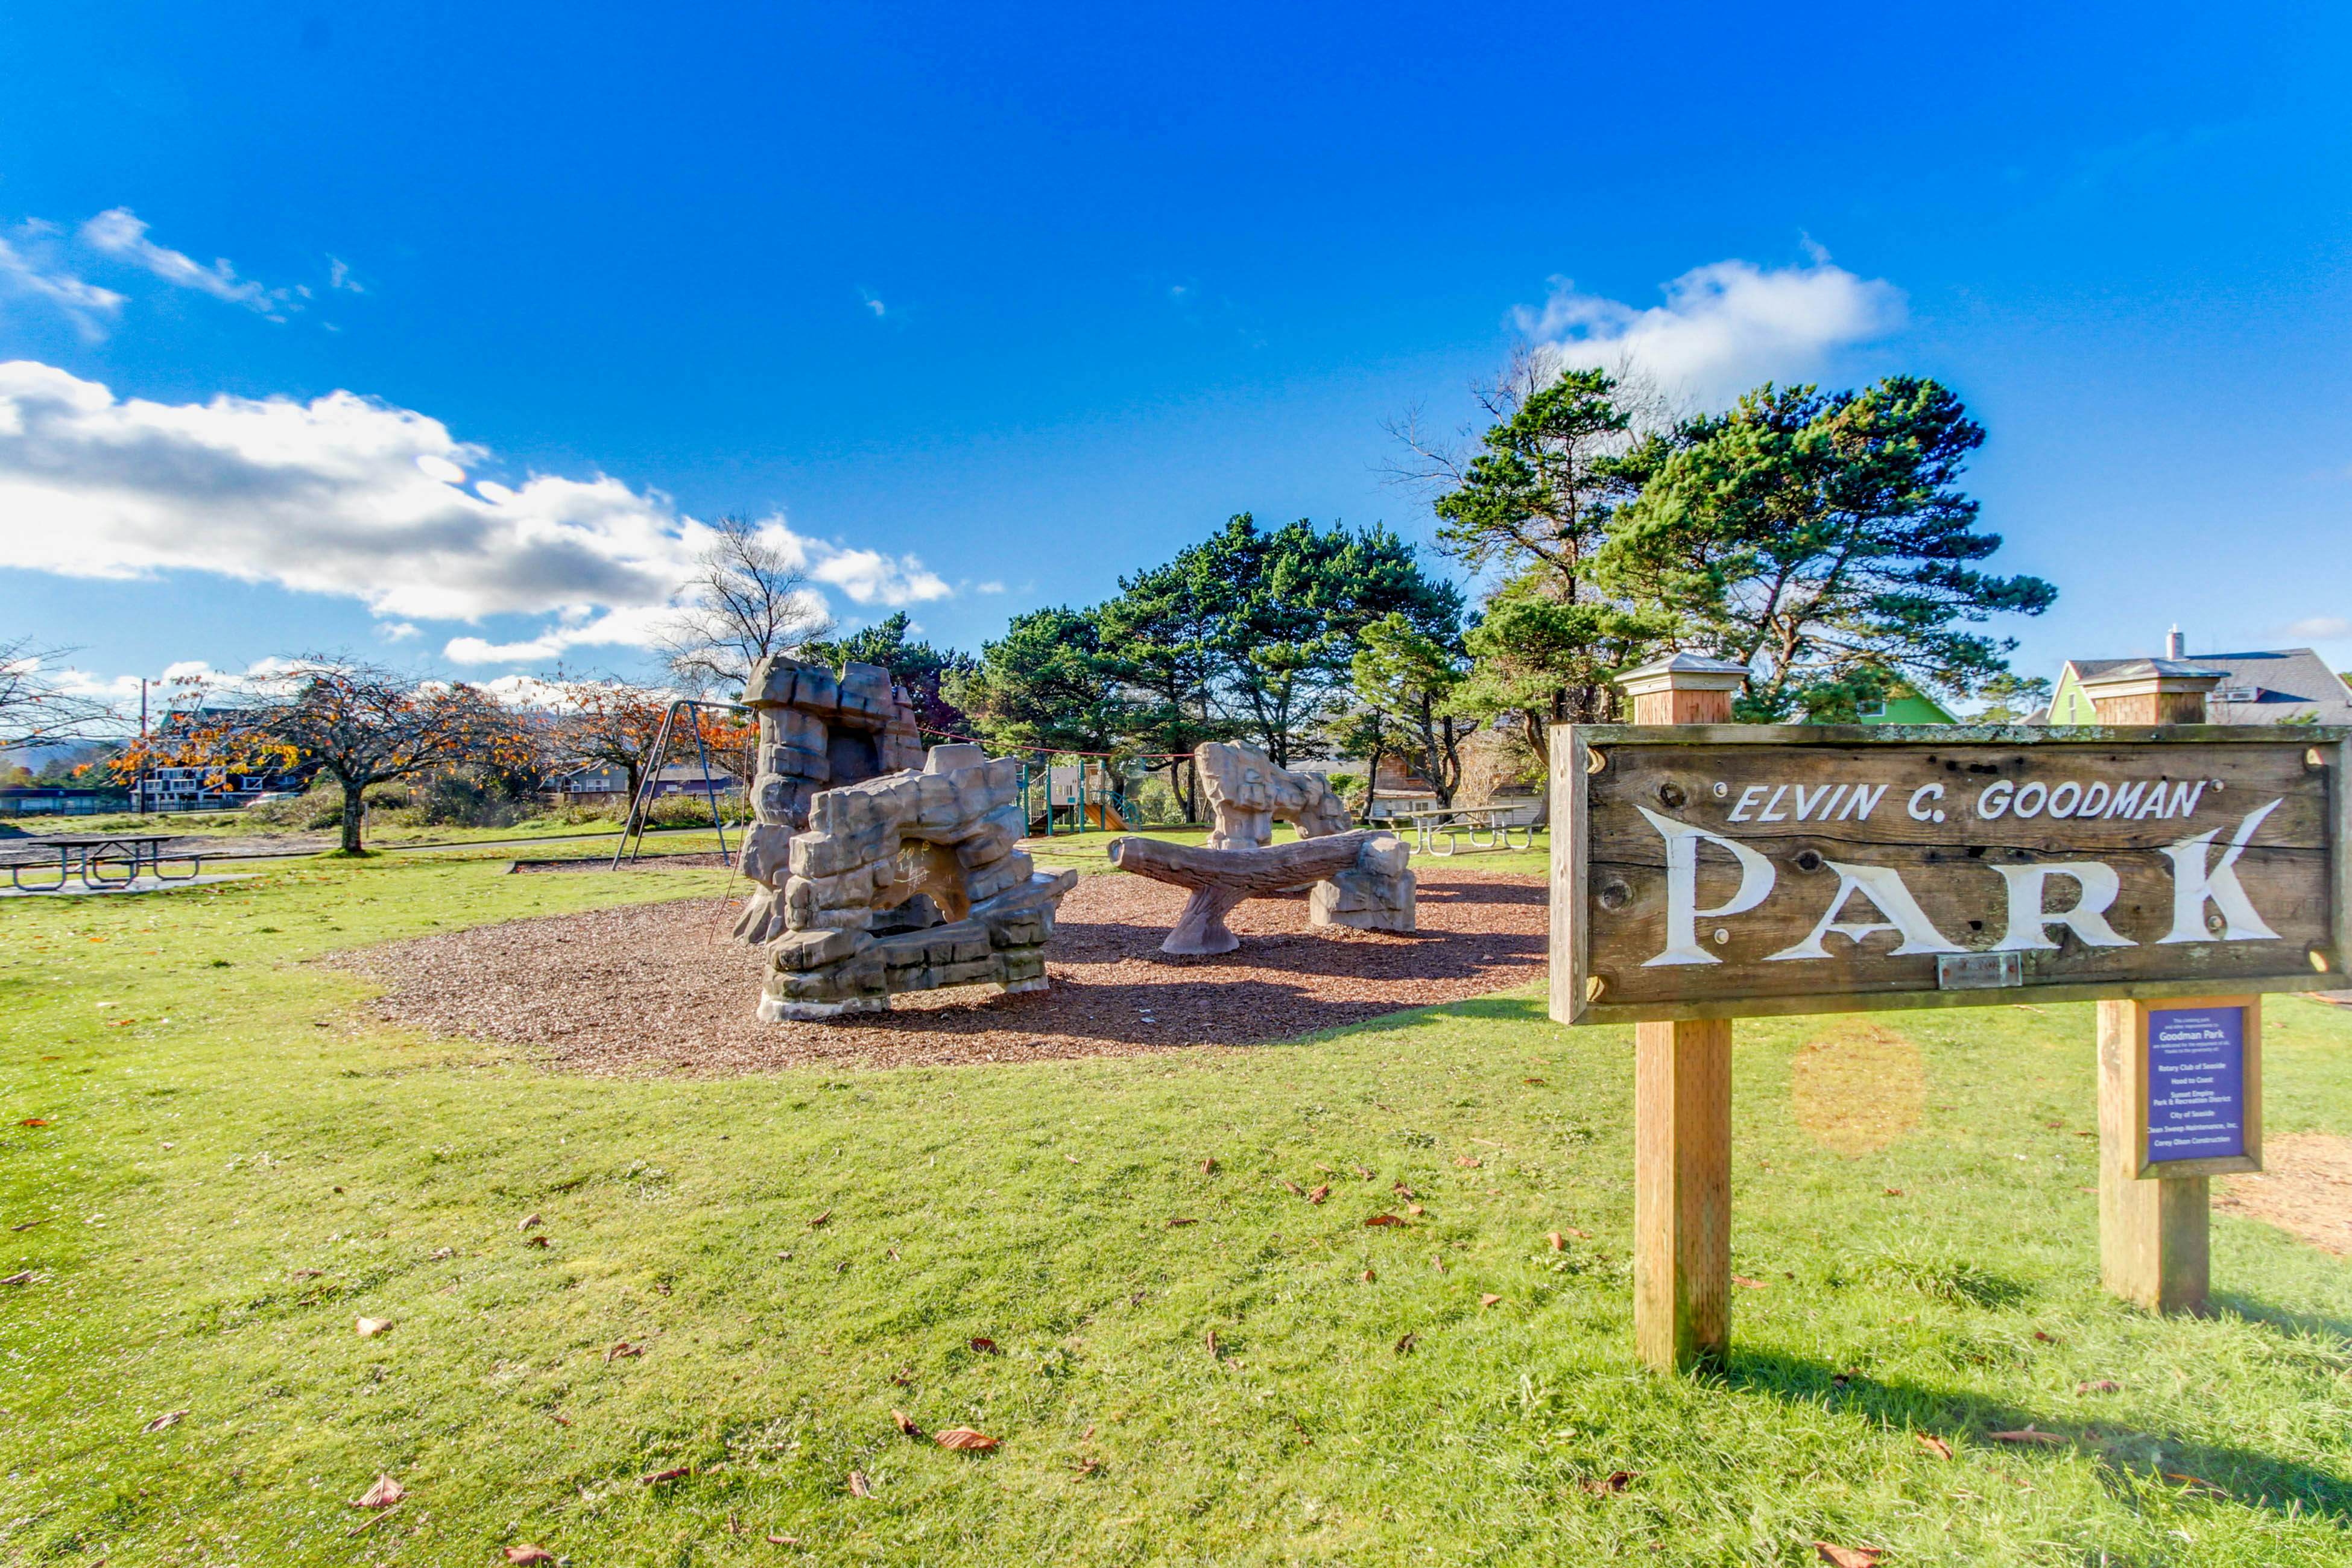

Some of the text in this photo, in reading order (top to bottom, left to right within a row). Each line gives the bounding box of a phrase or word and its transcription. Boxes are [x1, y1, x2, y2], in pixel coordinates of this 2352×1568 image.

[1727, 780, 2208, 823] ELVIN C. GOODMAN
[1634, 797, 2283, 966] PARK
[2159, 1029, 2225, 1041] Goodman Park
